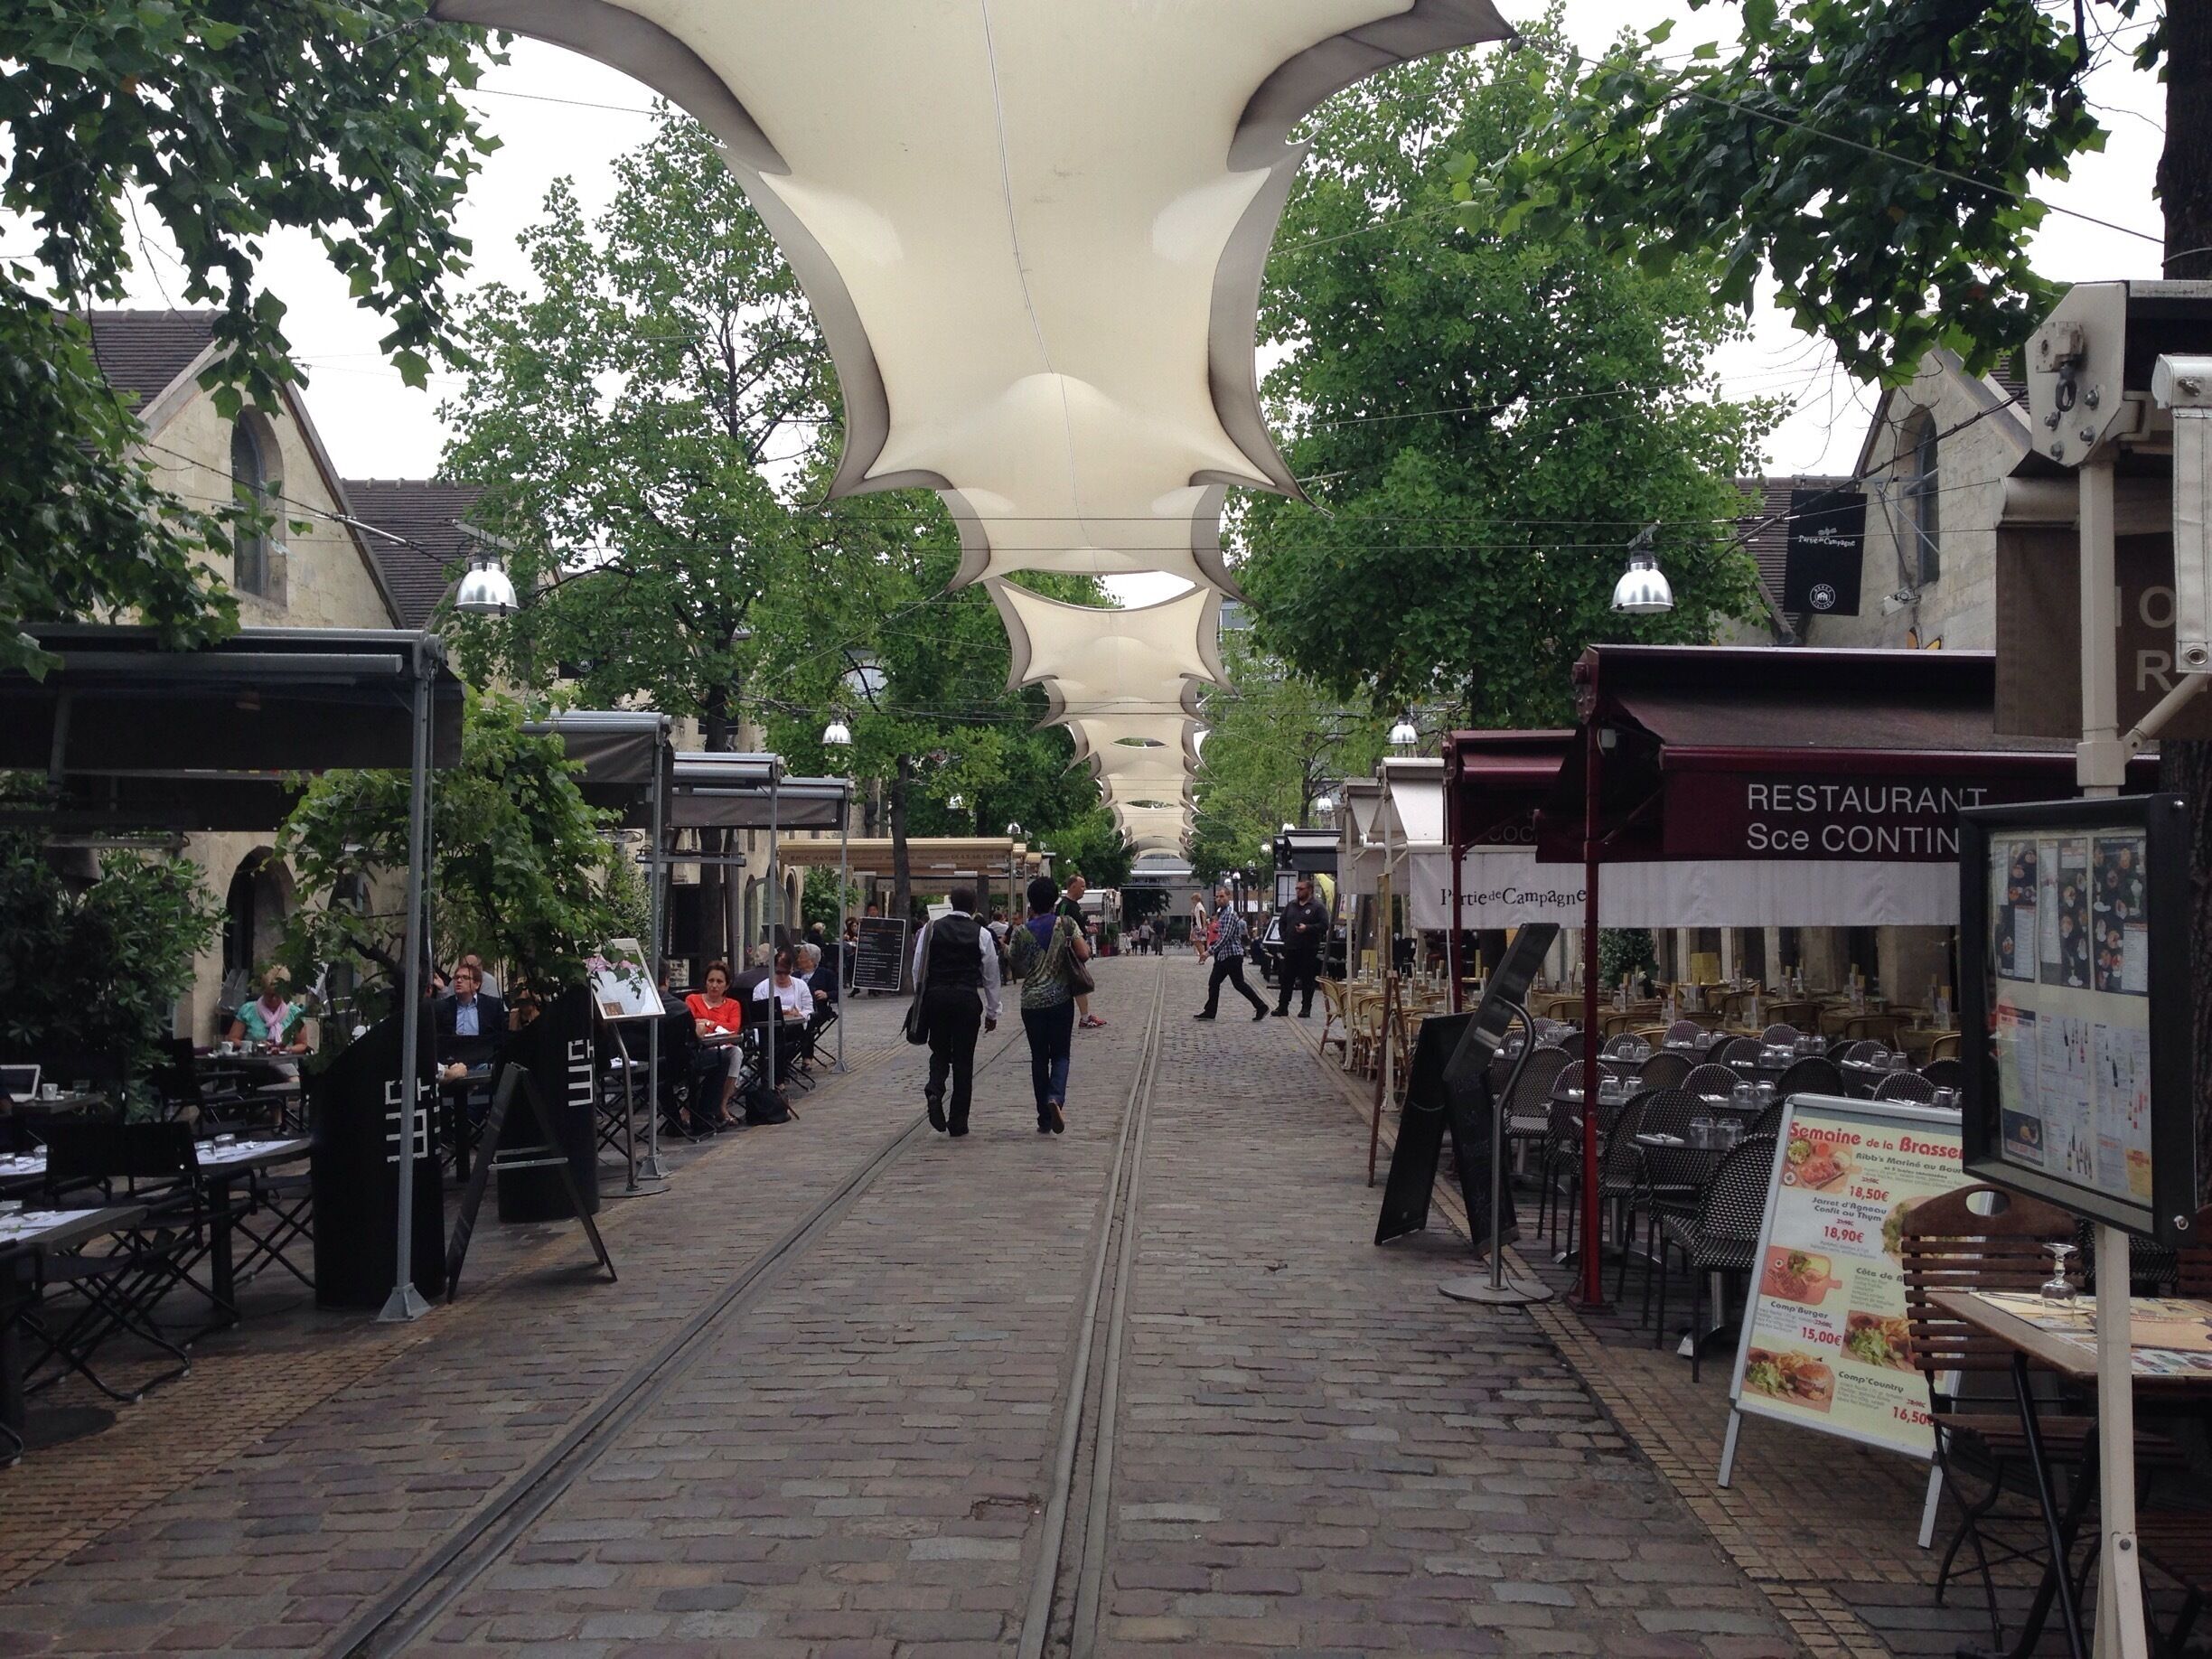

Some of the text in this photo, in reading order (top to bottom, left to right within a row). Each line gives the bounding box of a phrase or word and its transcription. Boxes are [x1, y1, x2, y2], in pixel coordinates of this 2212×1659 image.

[1748, 783, 1988, 813] RESTAURANT
[1747, 822, 1810, 850] Sce
[1440, 888, 1487, 906] Prtie
[1789, 1121, 1861, 1146] Semaine
[1866, 1138, 1879, 1148] de
[1883, 1139, 1893, 1150] la
[1923, 1163, 1936, 1171] au
[1812, 1196, 1840, 1207] Jarret
[1850, 1186, 1890, 1203] 18,50€
[1814, 1205, 1840, 1215] Confit
[1857, 1212, 1882, 1223] Thym
[1823, 1225, 1865, 1243] 18,90€
[1856, 1267, 1877, 1278] Côte
[1879, 1272, 1893, 1280] de
[1801, 1326, 1842, 1346] 15,00€
